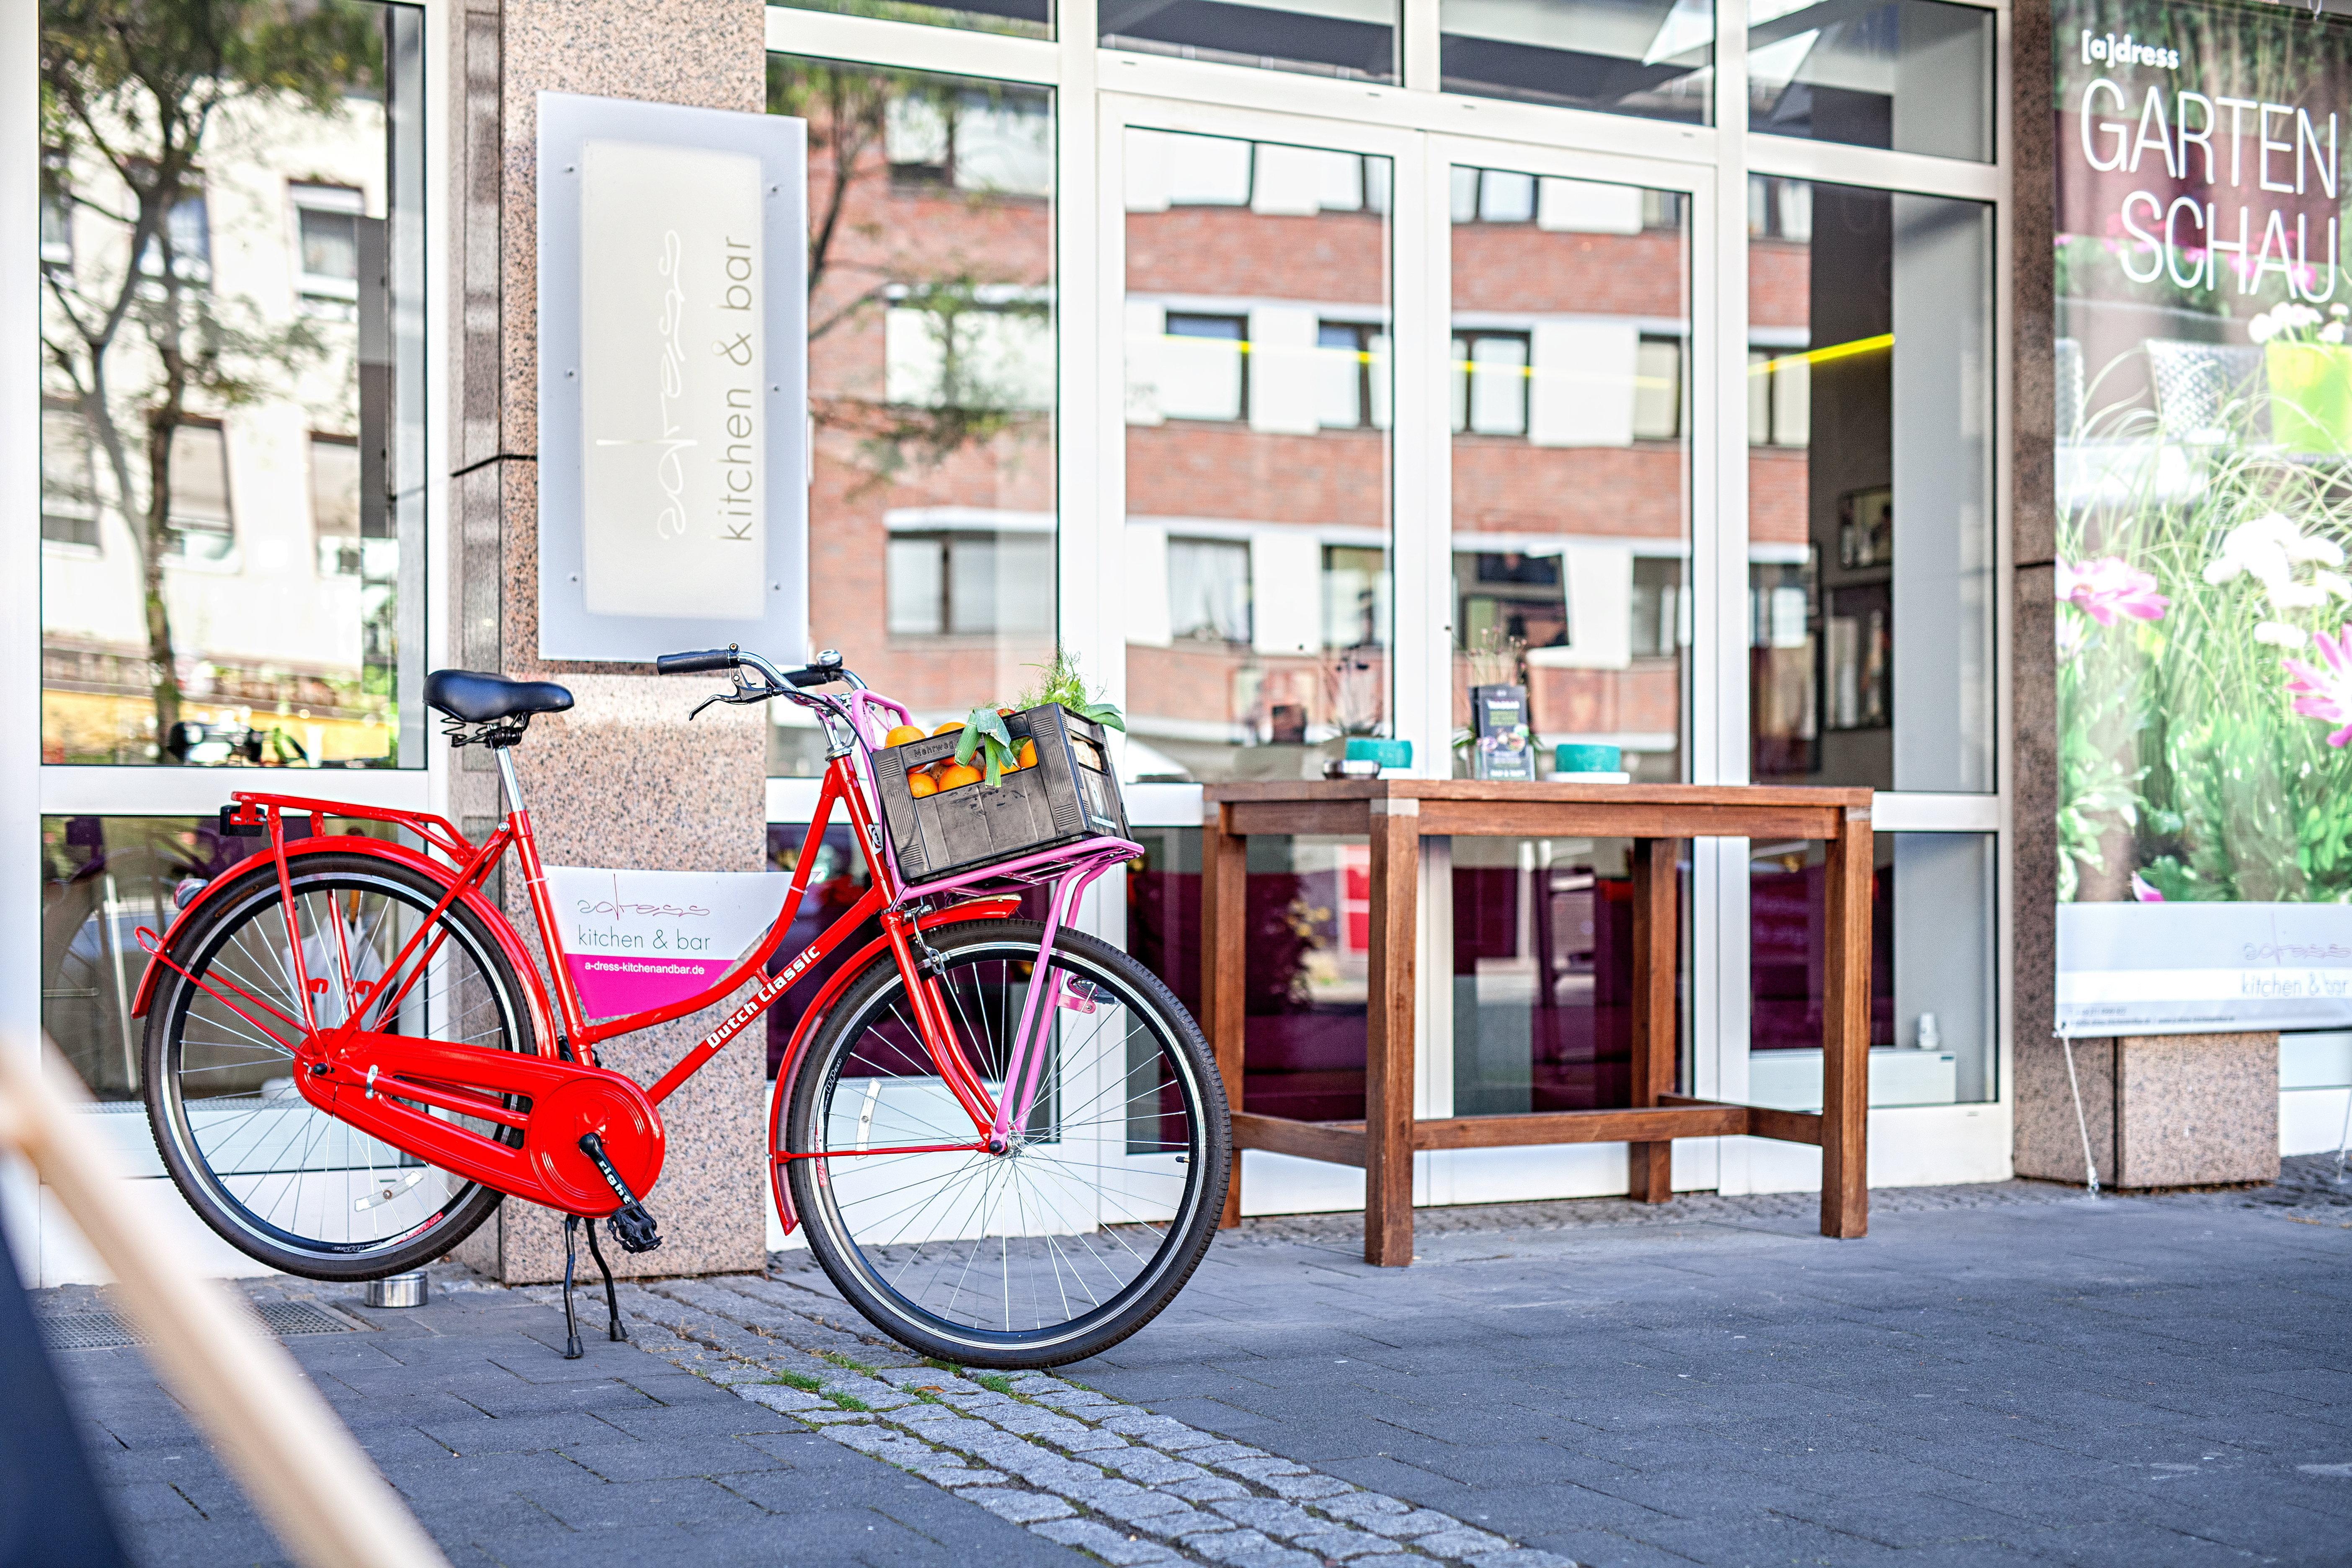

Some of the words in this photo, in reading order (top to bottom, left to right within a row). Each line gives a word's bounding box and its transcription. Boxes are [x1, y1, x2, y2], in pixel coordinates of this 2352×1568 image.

[2081, 29, 2180, 70] [a]dress
[2081, 78, 2337, 199] GARTEN
[2120, 191, 2337, 304] SCHAU
[709, 236, 752, 312] bar
[711, 331, 753, 367] &
[710, 387, 752, 542] kitchen
[578, 925, 644, 948] kitchen
[653, 929, 668, 949] &
[677, 929, 710, 951] bar
[585, 962, 705, 975] a-dress-kitchenandbar.de
[2241, 972, 2302, 997] kitchen
[706, 1001, 759, 1049] Dutch
[758, 945, 821, 1003] Classic
[599, 1161, 631, 1204] right
